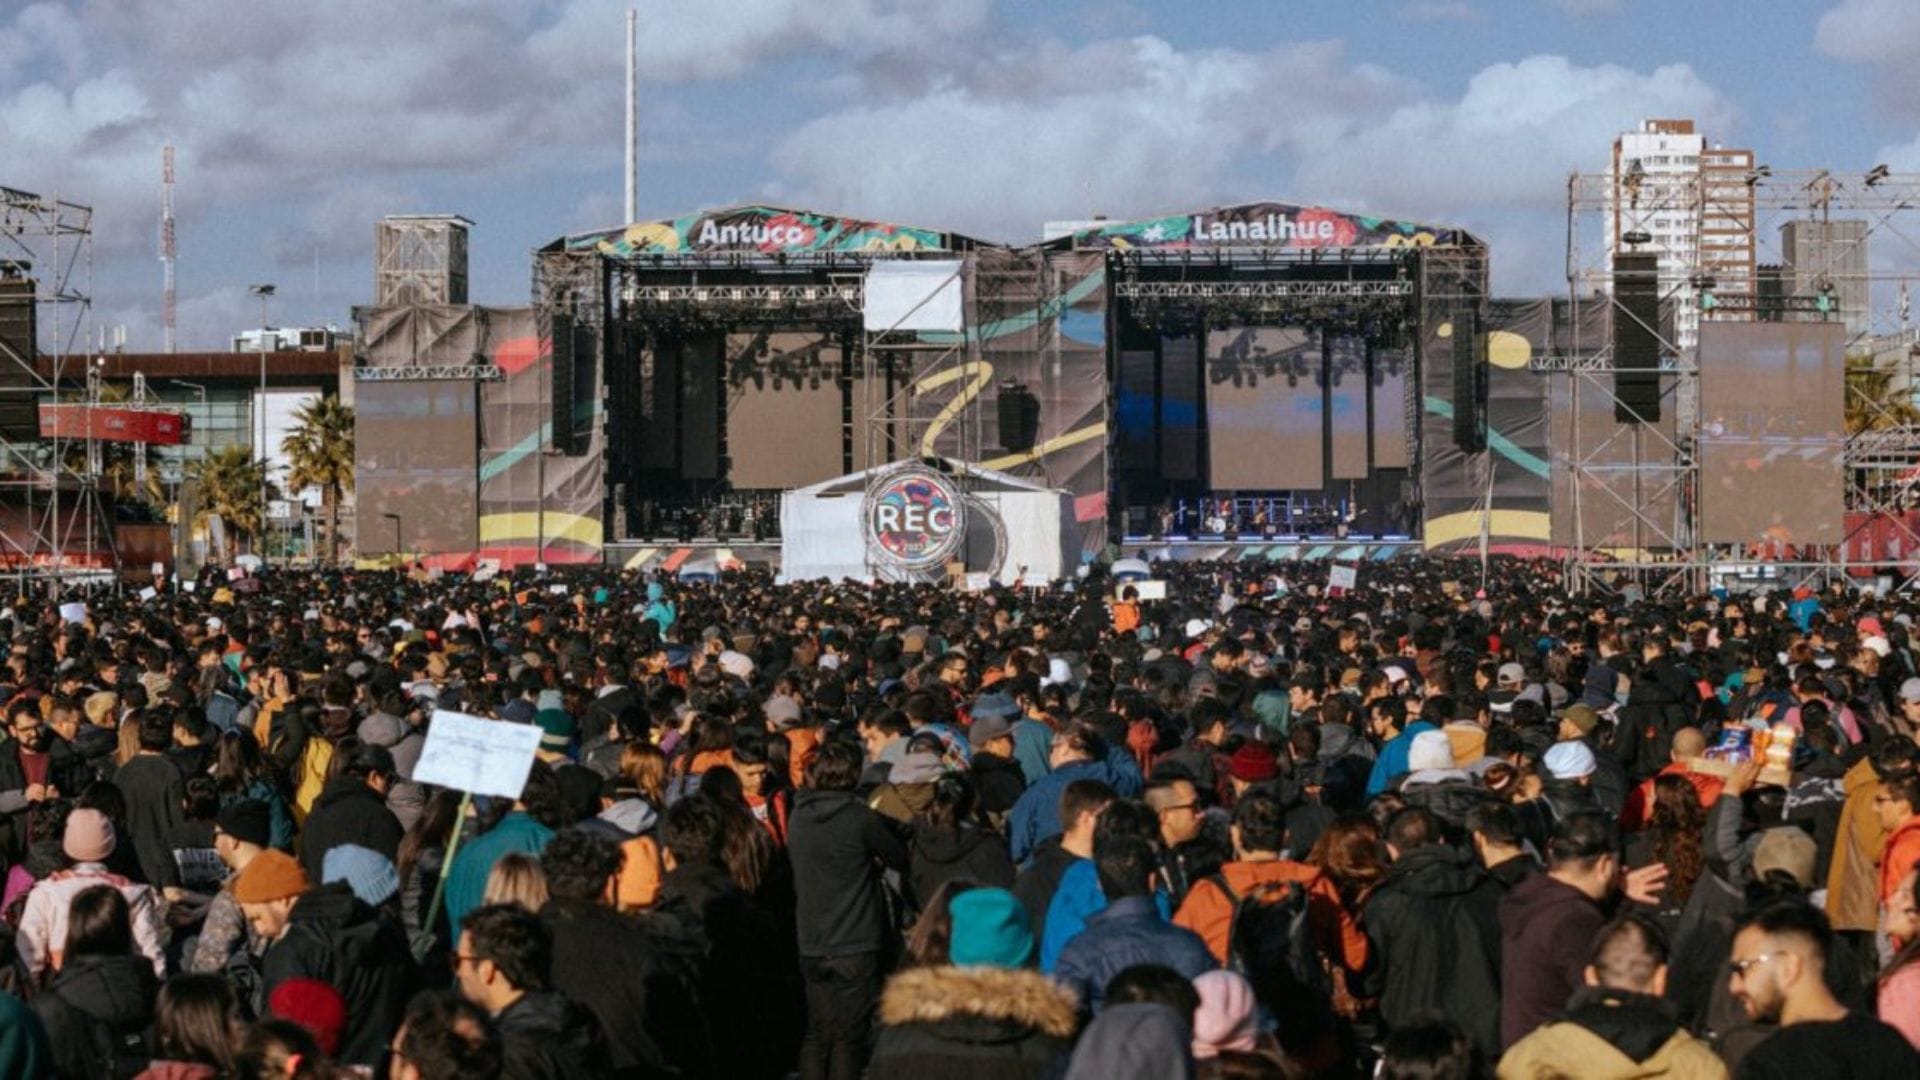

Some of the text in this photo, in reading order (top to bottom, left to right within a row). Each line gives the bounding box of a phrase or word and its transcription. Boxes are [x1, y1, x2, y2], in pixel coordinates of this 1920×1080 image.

[699, 219, 806, 245] Antuco
[1194, 213, 1334, 239] Lanalhue
[878, 504, 951, 533] REC
